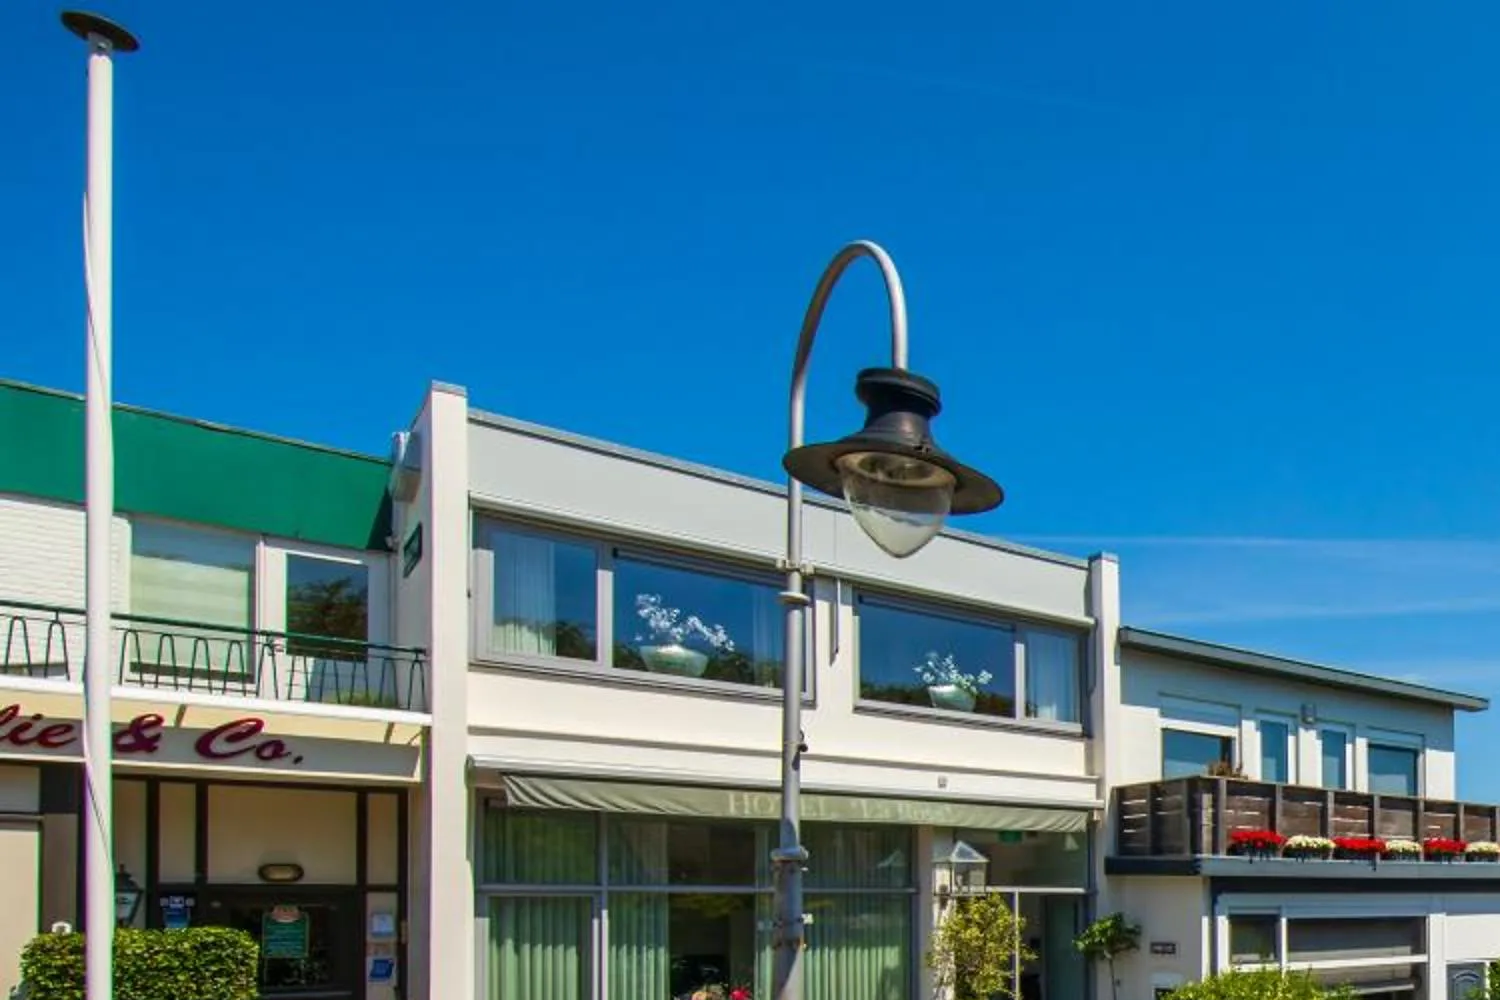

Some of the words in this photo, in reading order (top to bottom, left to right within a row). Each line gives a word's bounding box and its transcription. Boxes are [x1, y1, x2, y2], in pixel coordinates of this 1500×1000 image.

[112, 714, 164, 753] &
[195, 718, 304, 765] Co.
[729, 792, 836, 818] HOEL
